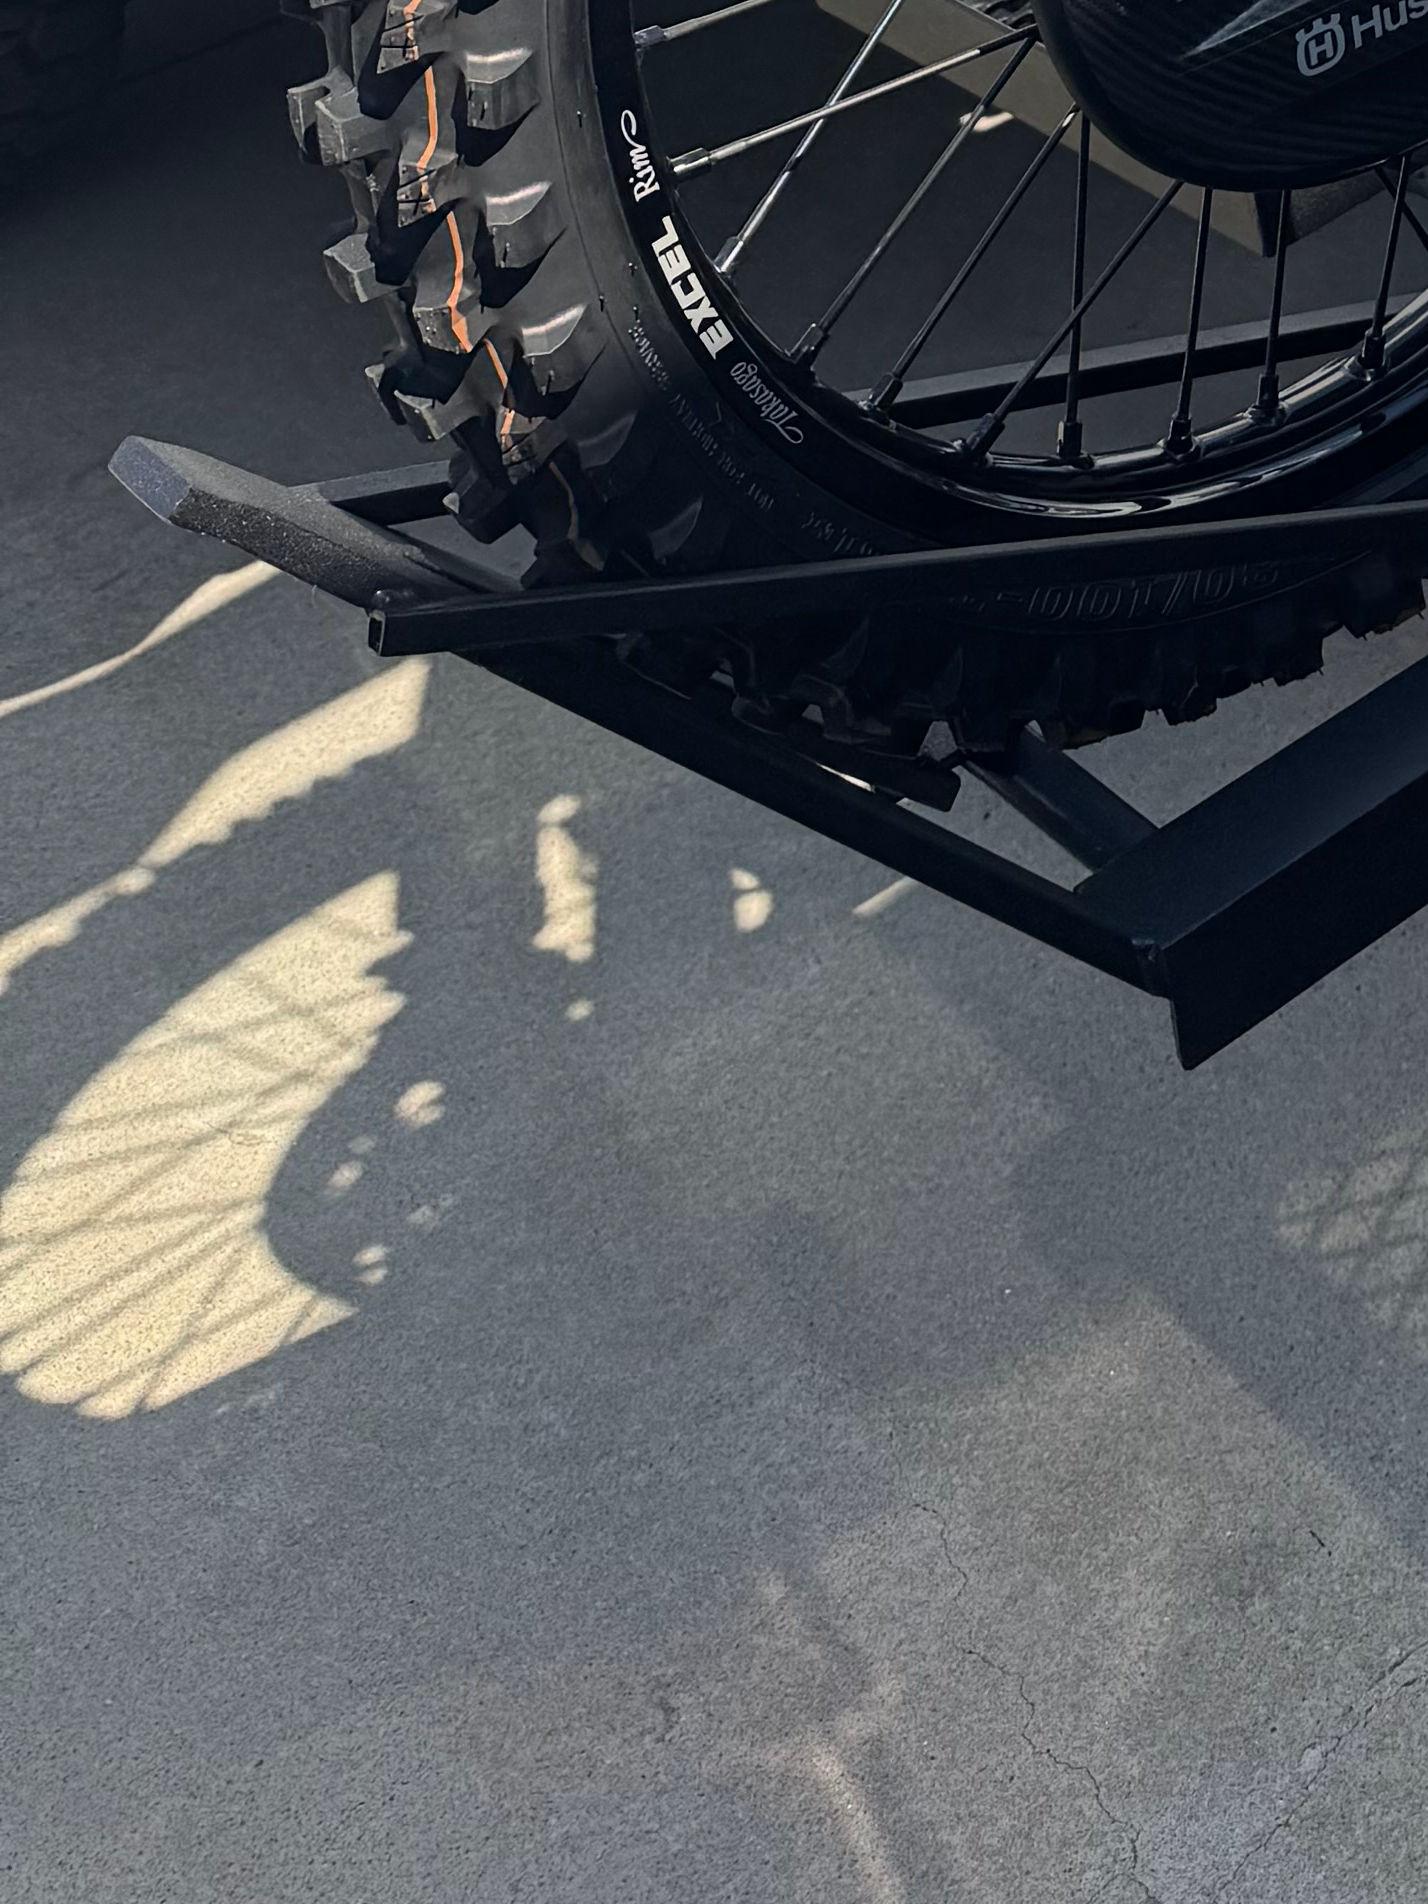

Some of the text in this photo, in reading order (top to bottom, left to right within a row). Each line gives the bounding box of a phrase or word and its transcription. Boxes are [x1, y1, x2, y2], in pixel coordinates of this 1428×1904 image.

[620, 109, 661, 203] Rim
[651, 215, 734, 360] EXCEL
[729, 360, 804, 445] Takasago
